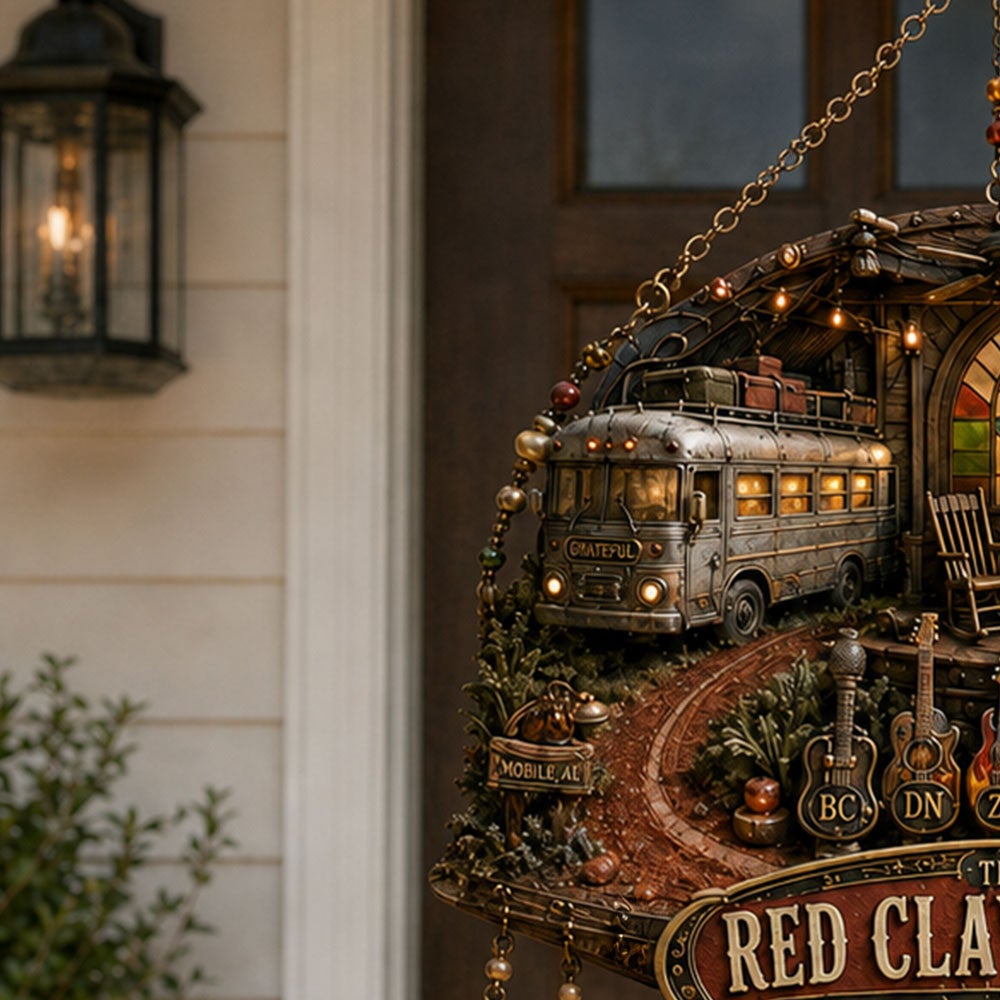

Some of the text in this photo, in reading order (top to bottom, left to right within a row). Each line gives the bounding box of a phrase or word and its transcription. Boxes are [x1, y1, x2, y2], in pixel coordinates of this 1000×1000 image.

[819, 793, 857, 822] BC
[903, 790, 945, 819] DN
[721, 903, 849, 994] RED
